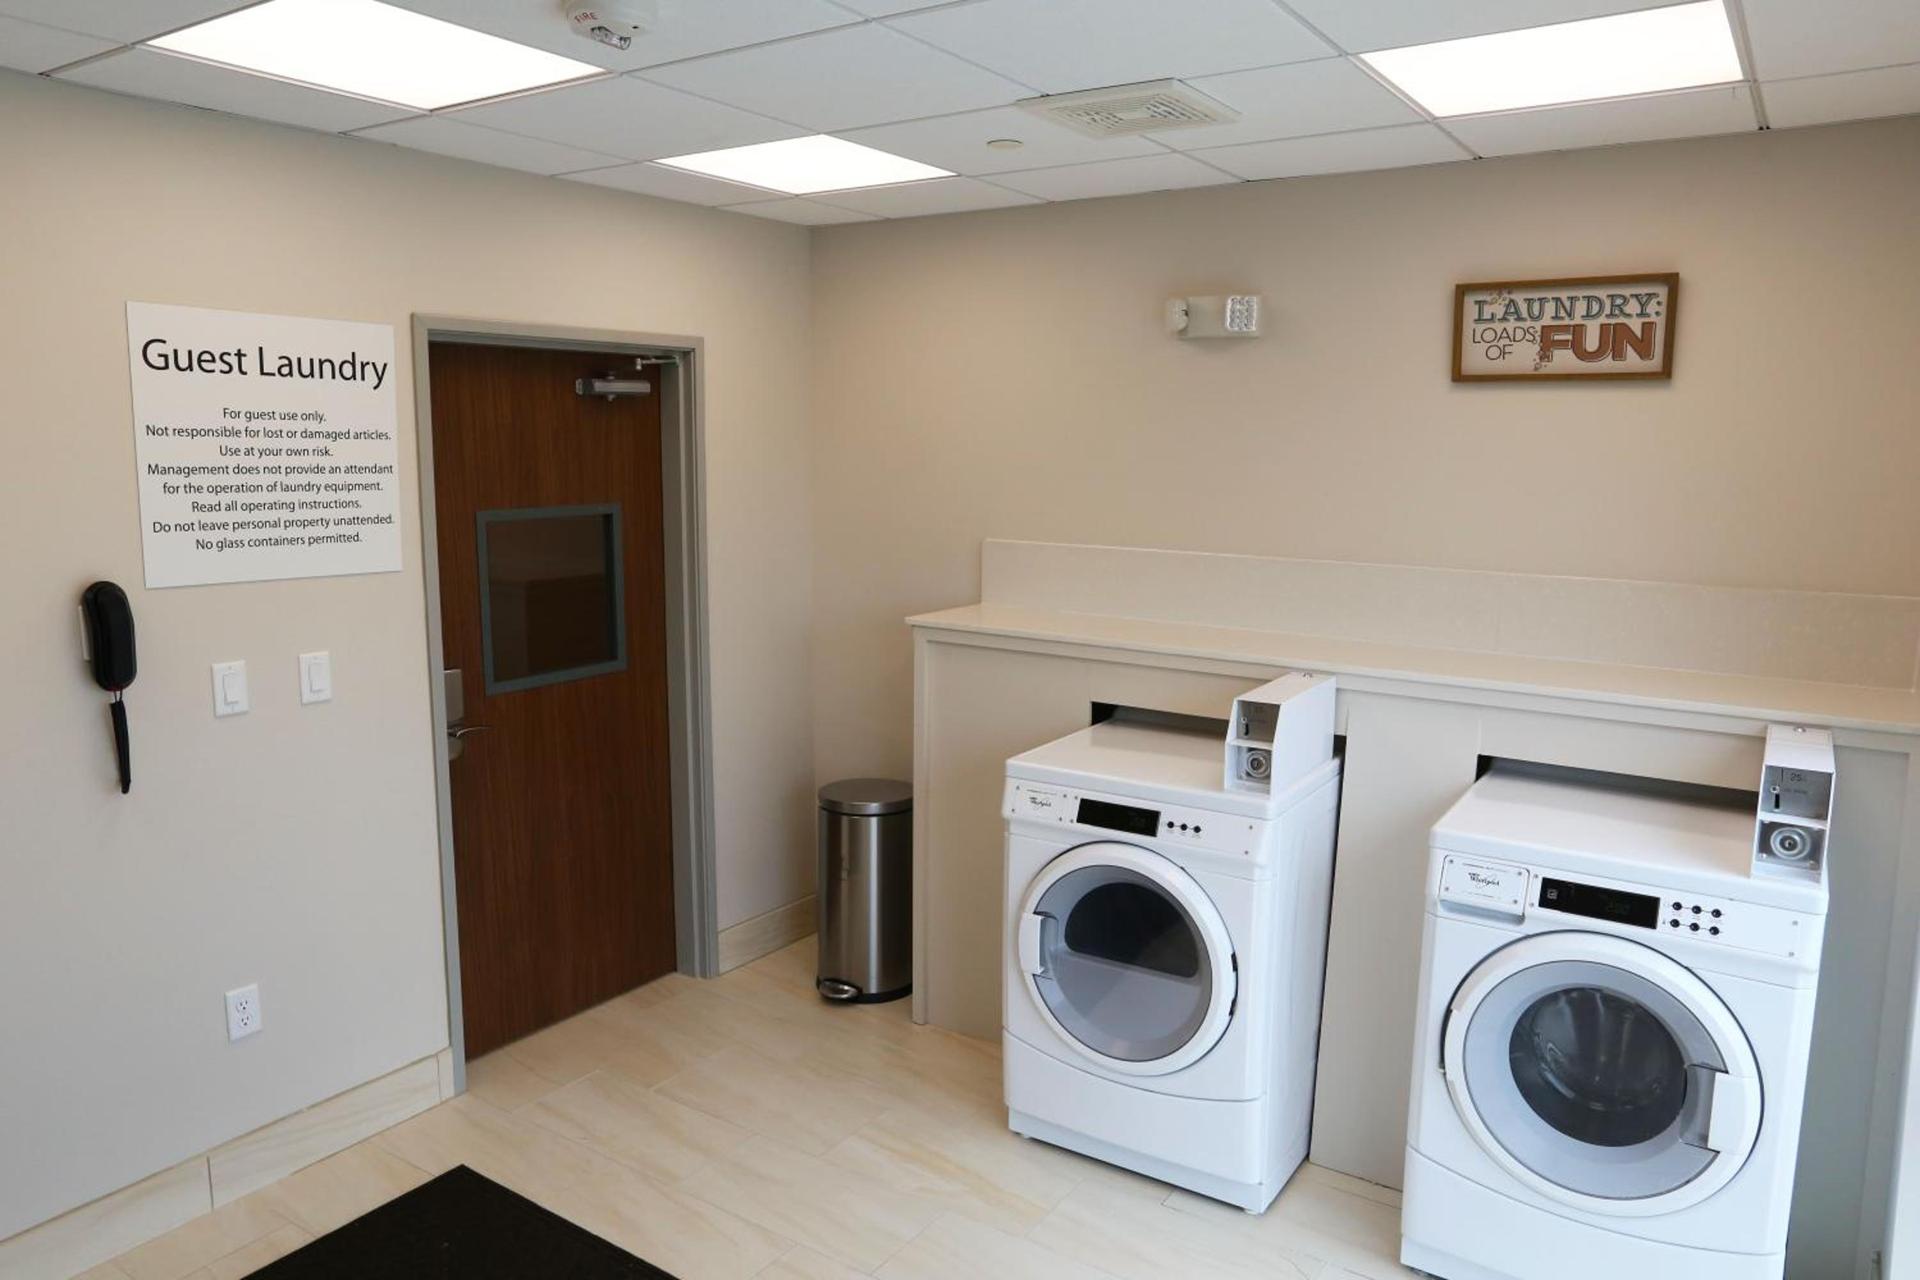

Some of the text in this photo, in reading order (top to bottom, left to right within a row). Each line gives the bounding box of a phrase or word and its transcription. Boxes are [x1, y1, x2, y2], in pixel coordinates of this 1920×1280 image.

[574, 11, 600, 23] FIRE
[1473, 291, 1664, 324] LAUNDRY:
[1472, 325, 1536, 344] LOADS
[1539, 320, 1657, 363] FUN
[1485, 343, 1514, 361] OF
[142, 338, 389, 391] Guest Laundry
[223, 407, 326, 424] For guest use only.
[145, 424, 392, 442] Not responsible for lost or damaged articles.
[219, 445, 334, 459] Use at your own risk.
[147, 463, 393, 478] Management does not provide an attendant
[163, 481, 383, 496] for the operation of laundry equipment.
[191, 499, 361, 513] Read all operating instructions.
[152, 514, 394, 533] Do not leave personal property unattended.
[195, 532, 362, 552] No glass containers permitted.
